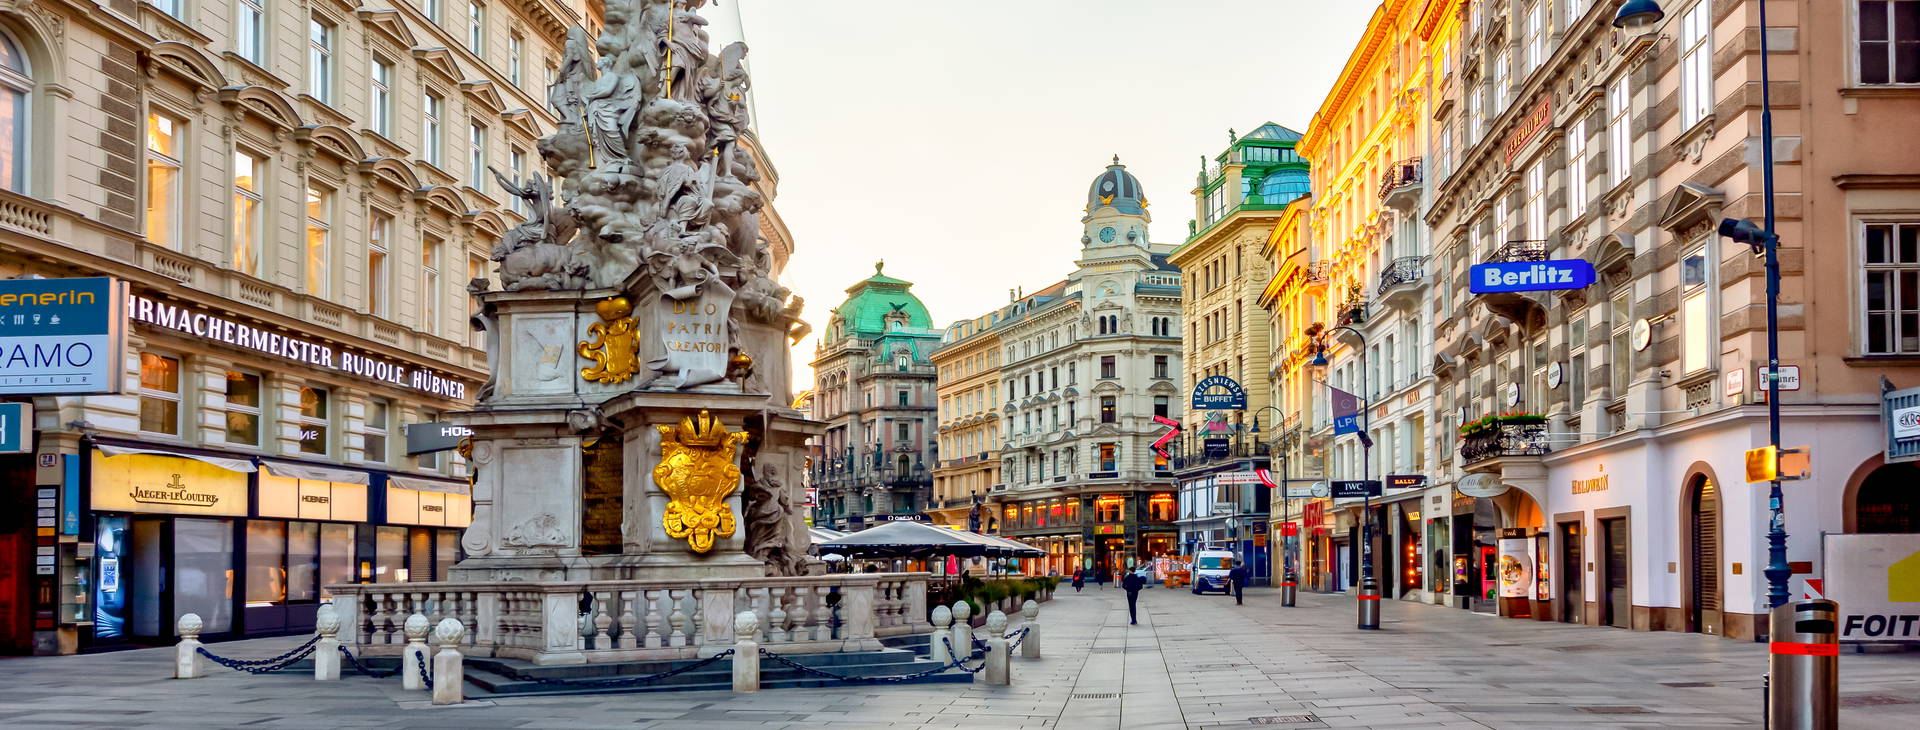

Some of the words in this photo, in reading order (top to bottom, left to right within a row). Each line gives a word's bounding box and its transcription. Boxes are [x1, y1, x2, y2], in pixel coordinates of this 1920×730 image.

[1535, 102, 1549, 128] HOF
[1484, 264, 1574, 287] Berlitz
[0, 342, 92, 368] AMO
[342, 352, 404, 384] RUDOLF
[413, 369, 465, 400] HÜBNER
[1345, 482, 1364, 491] IWC
[1843, 614, 1920, 637] FOIT
